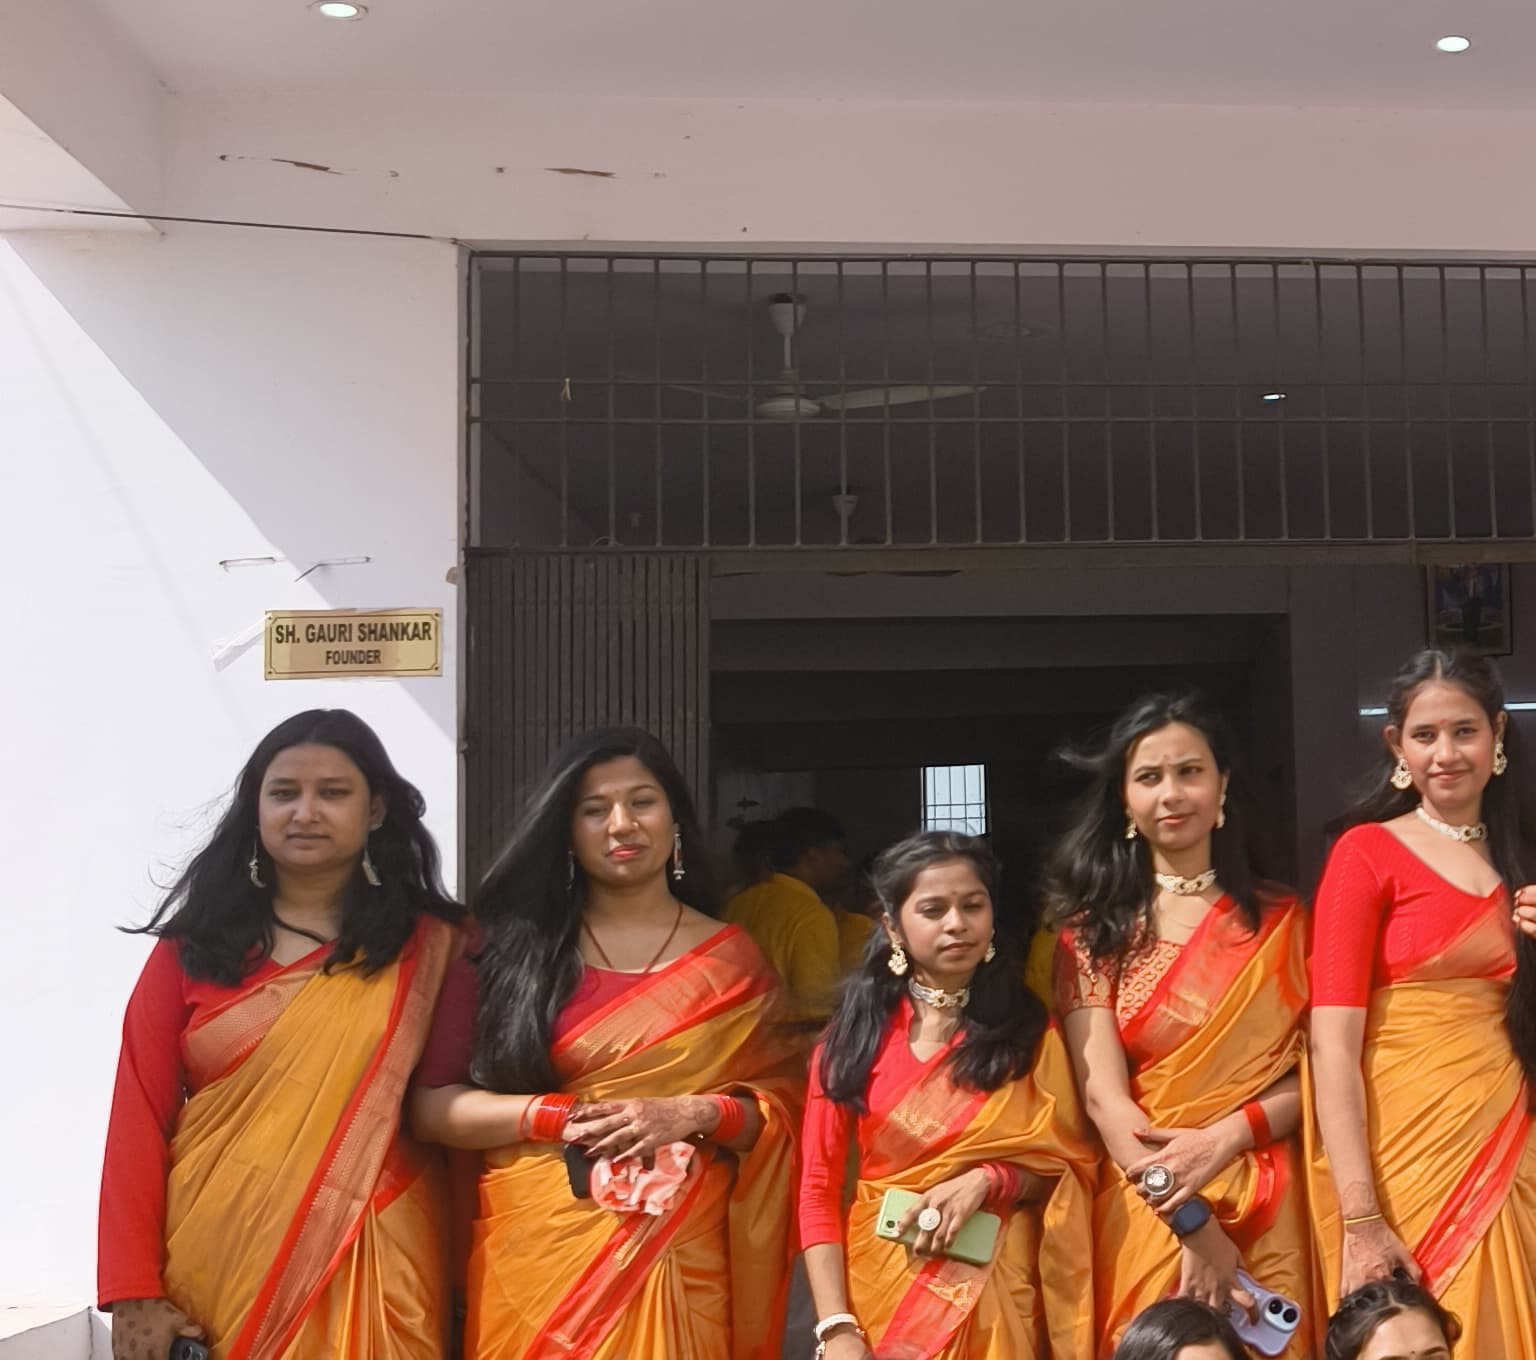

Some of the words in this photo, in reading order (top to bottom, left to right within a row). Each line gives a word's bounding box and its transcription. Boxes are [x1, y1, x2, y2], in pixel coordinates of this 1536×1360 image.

[275, 625, 300, 644] SH.
[305, 623, 353, 643] GAURI
[357, 622, 432, 643] SHANKAR
[325, 650, 381, 665] FOUNDER
